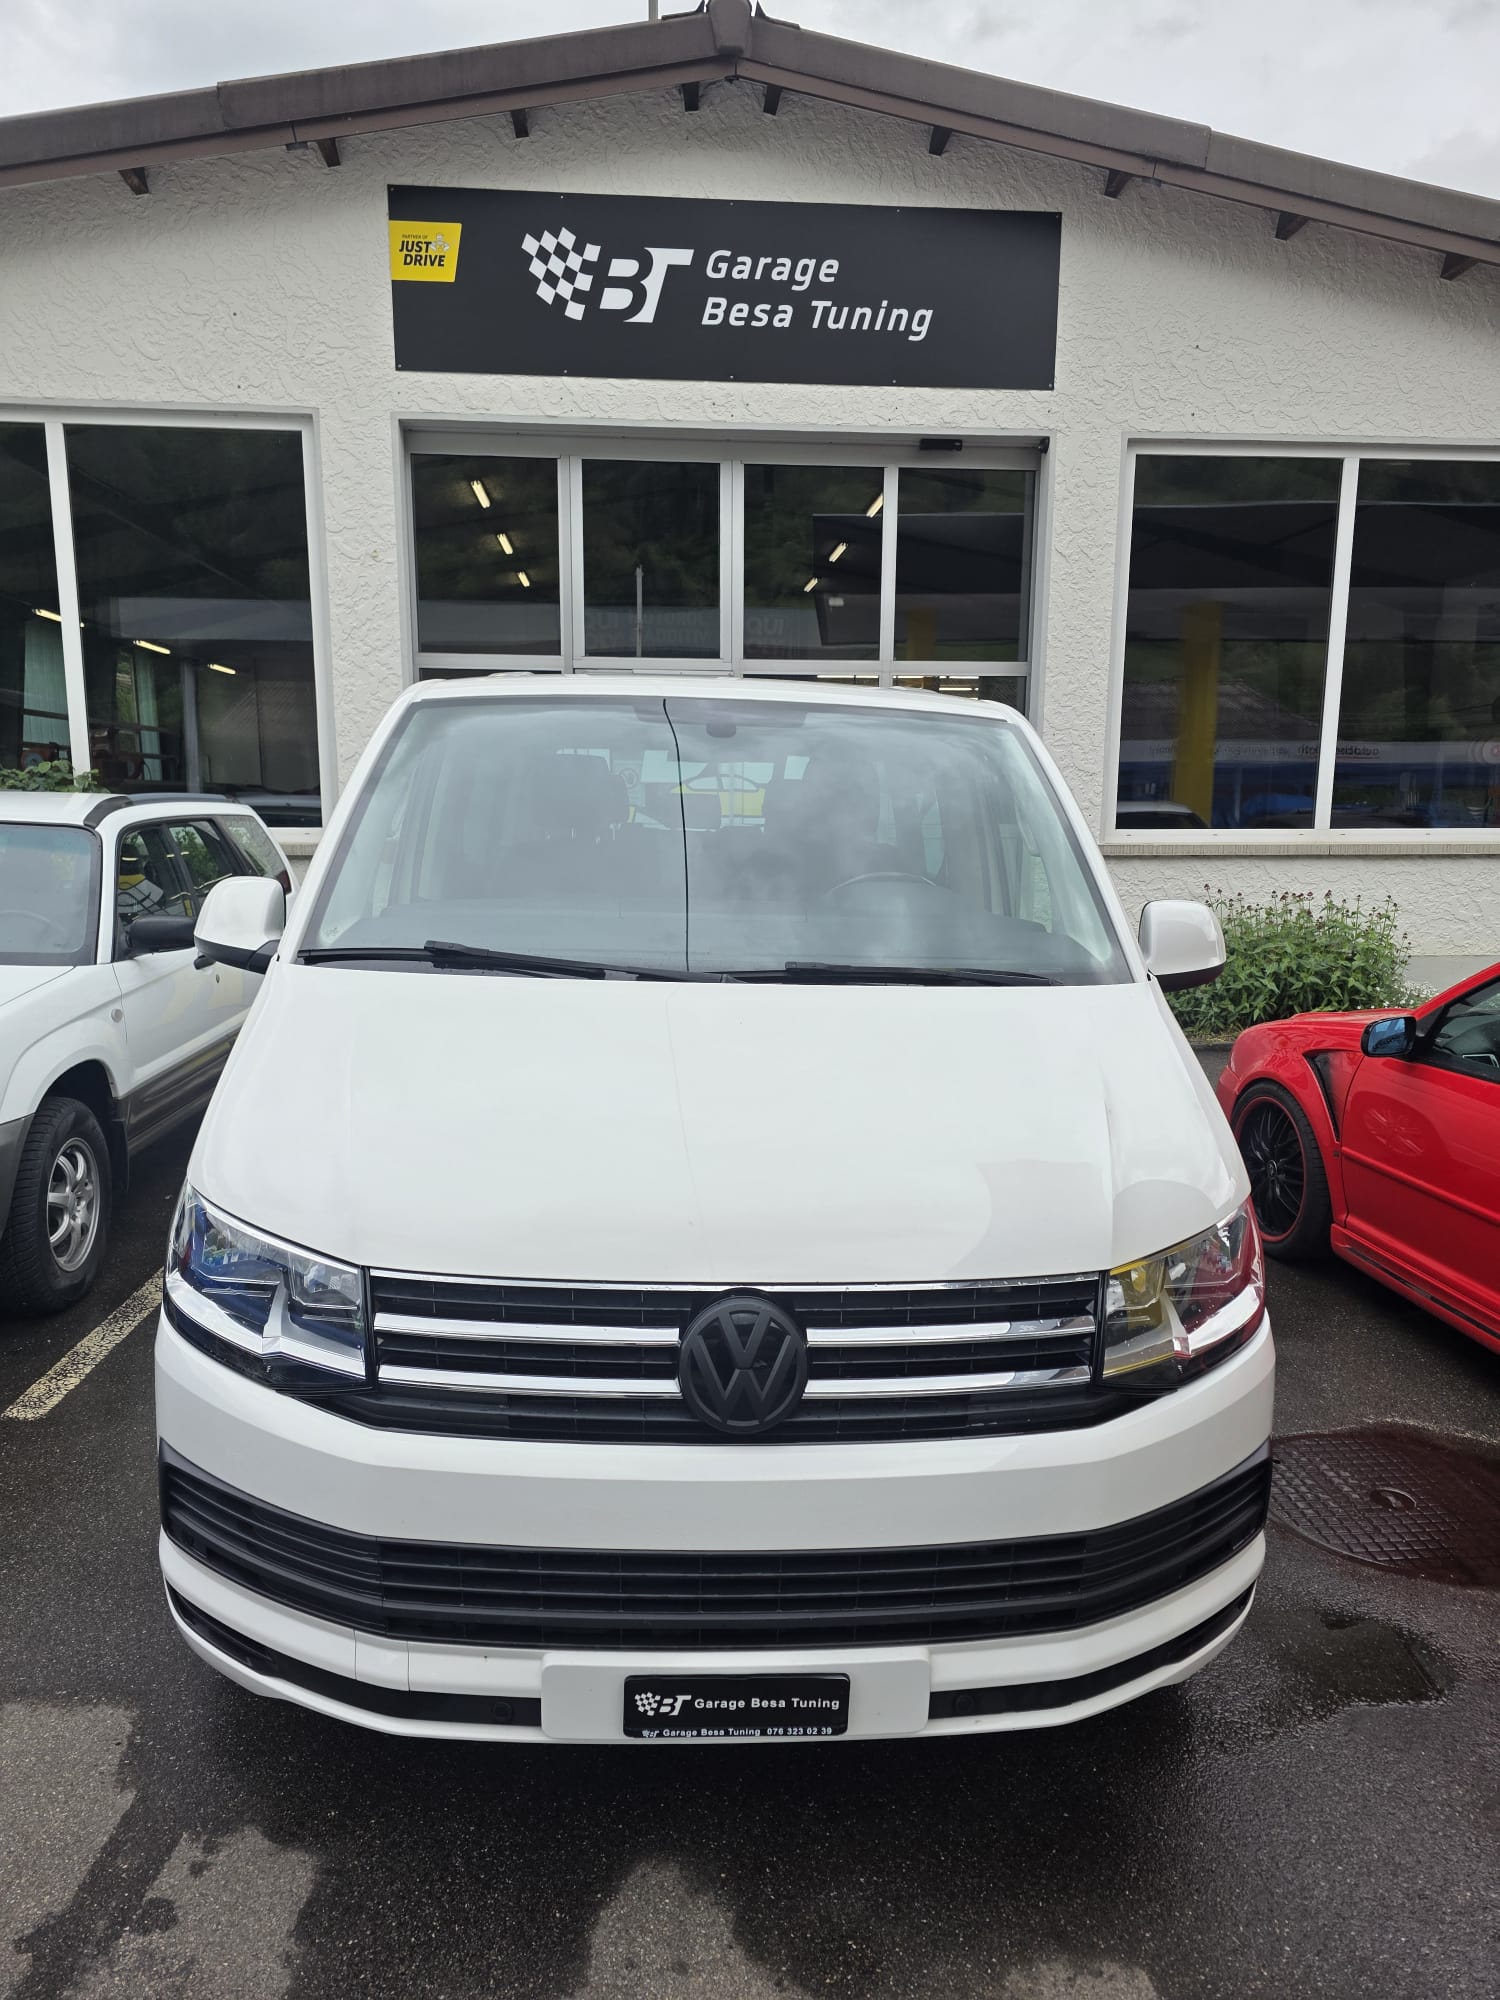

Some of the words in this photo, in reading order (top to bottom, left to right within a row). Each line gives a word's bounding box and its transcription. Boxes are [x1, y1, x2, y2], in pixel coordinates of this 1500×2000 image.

[399, 240, 432, 253] JUST
[403, 253, 446, 267] DRIVE
[705, 249, 839, 291] Garage
[600, 247, 694, 323] BT
[701, 297, 794, 328] Besa
[811, 300, 934, 342] Tuning
[694, 1698, 745, 1710] Garage
[751, 1698, 786, 1708] Besa
[791, 1698, 840, 1710] Tuning
[662, 1729, 697, 1737] Garage
[701, 1728, 725, 1736] Besa
[728, 1728, 761, 1737] Tuning
[767, 1727, 784, 1735] 076
[787, 1727, 804, 1735] 323
[806, 1727, 818, 1735] 02
[821, 1727, 833, 1735] 39
